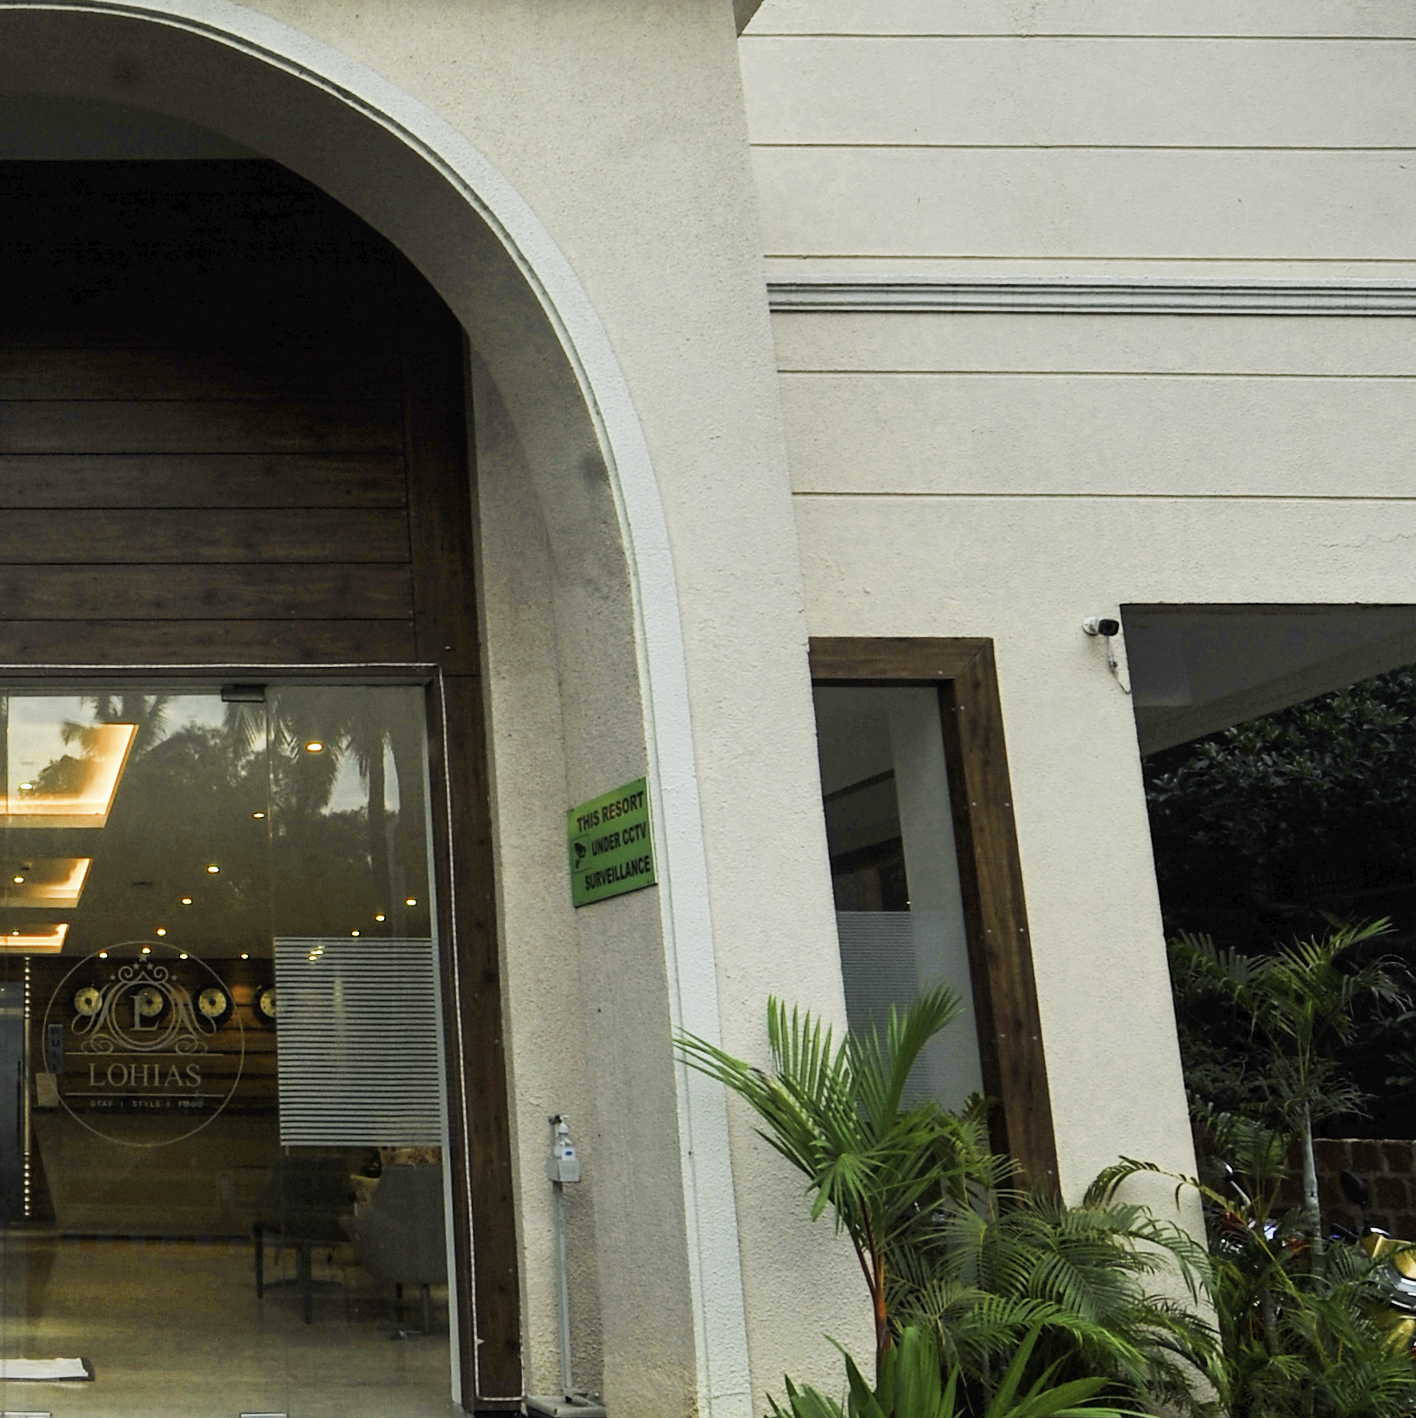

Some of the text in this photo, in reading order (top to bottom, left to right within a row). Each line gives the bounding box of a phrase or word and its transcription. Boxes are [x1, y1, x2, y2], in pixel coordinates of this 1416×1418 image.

[576, 790, 644, 832] THIS RESORT
[591, 821, 647, 856] UNDER CCTV
[585, 855, 651, 891] SURVEILLANCE
[130, 995, 159, 1031] L
[89, 1063, 202, 1088] LOHIAS
[90, 1100, 113, 1108] STAY
[132, 1100, 161, 1108] STYLE
